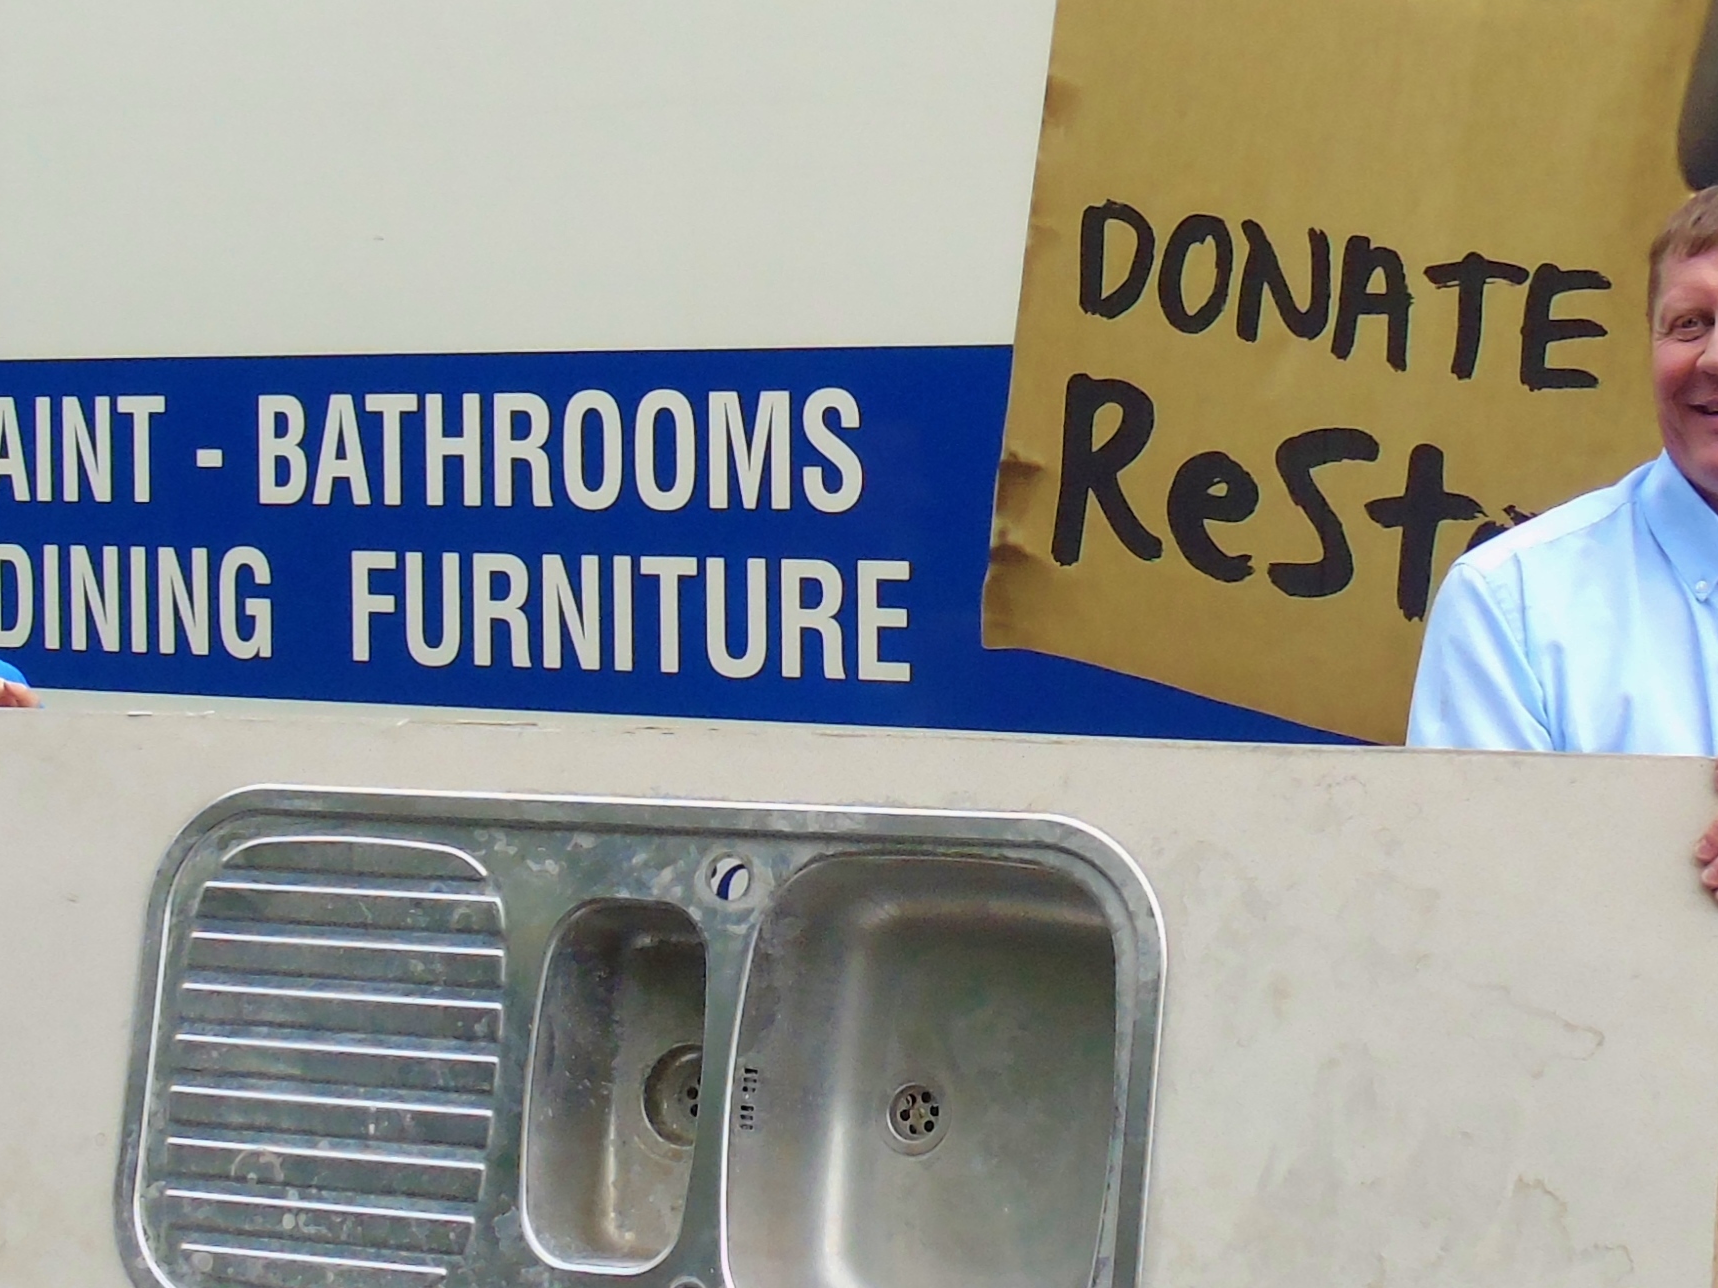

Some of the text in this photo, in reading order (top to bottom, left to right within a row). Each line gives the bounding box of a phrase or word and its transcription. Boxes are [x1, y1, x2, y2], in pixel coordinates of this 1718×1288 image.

[1079, 199, 1612, 392] DONATE
[257, 387, 863, 513] BATHROOMS
[1052, 372, 1539, 623] ReSt
[351, 549, 911, 682] FURNITURE
